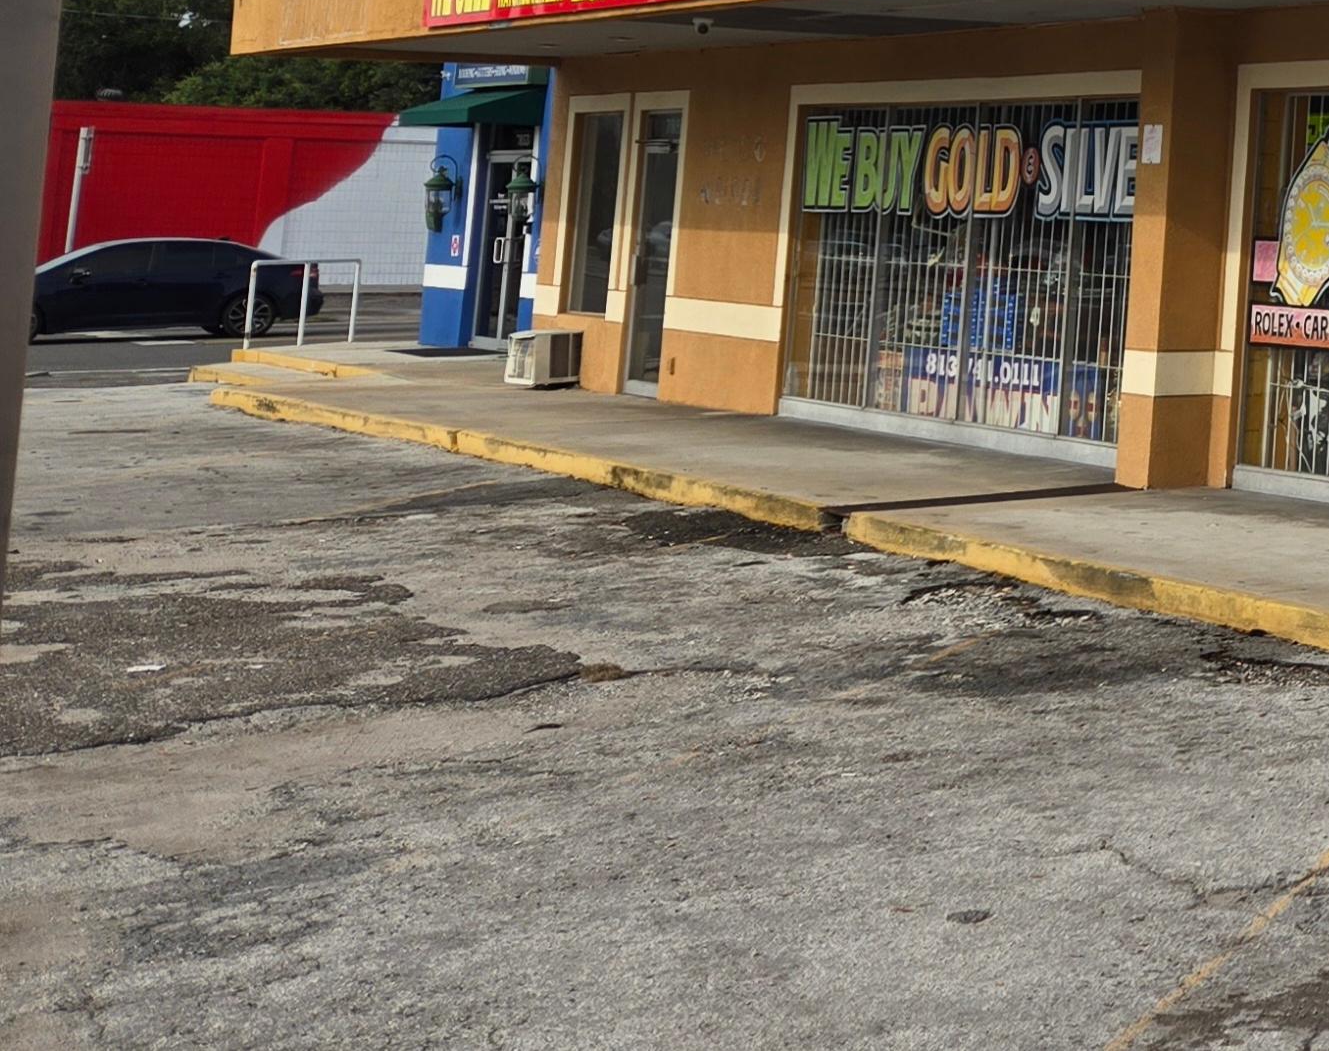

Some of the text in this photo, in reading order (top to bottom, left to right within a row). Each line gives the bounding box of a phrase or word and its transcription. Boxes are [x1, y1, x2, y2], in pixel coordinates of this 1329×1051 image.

[803, 118, 851, 211] WE
[852, 126, 924, 213] BUY
[923, 123, 1022, 216] GOLD
[1038, 124, 1138, 216] SILVE
[1254, 312, 1294, 338] ROLEX
